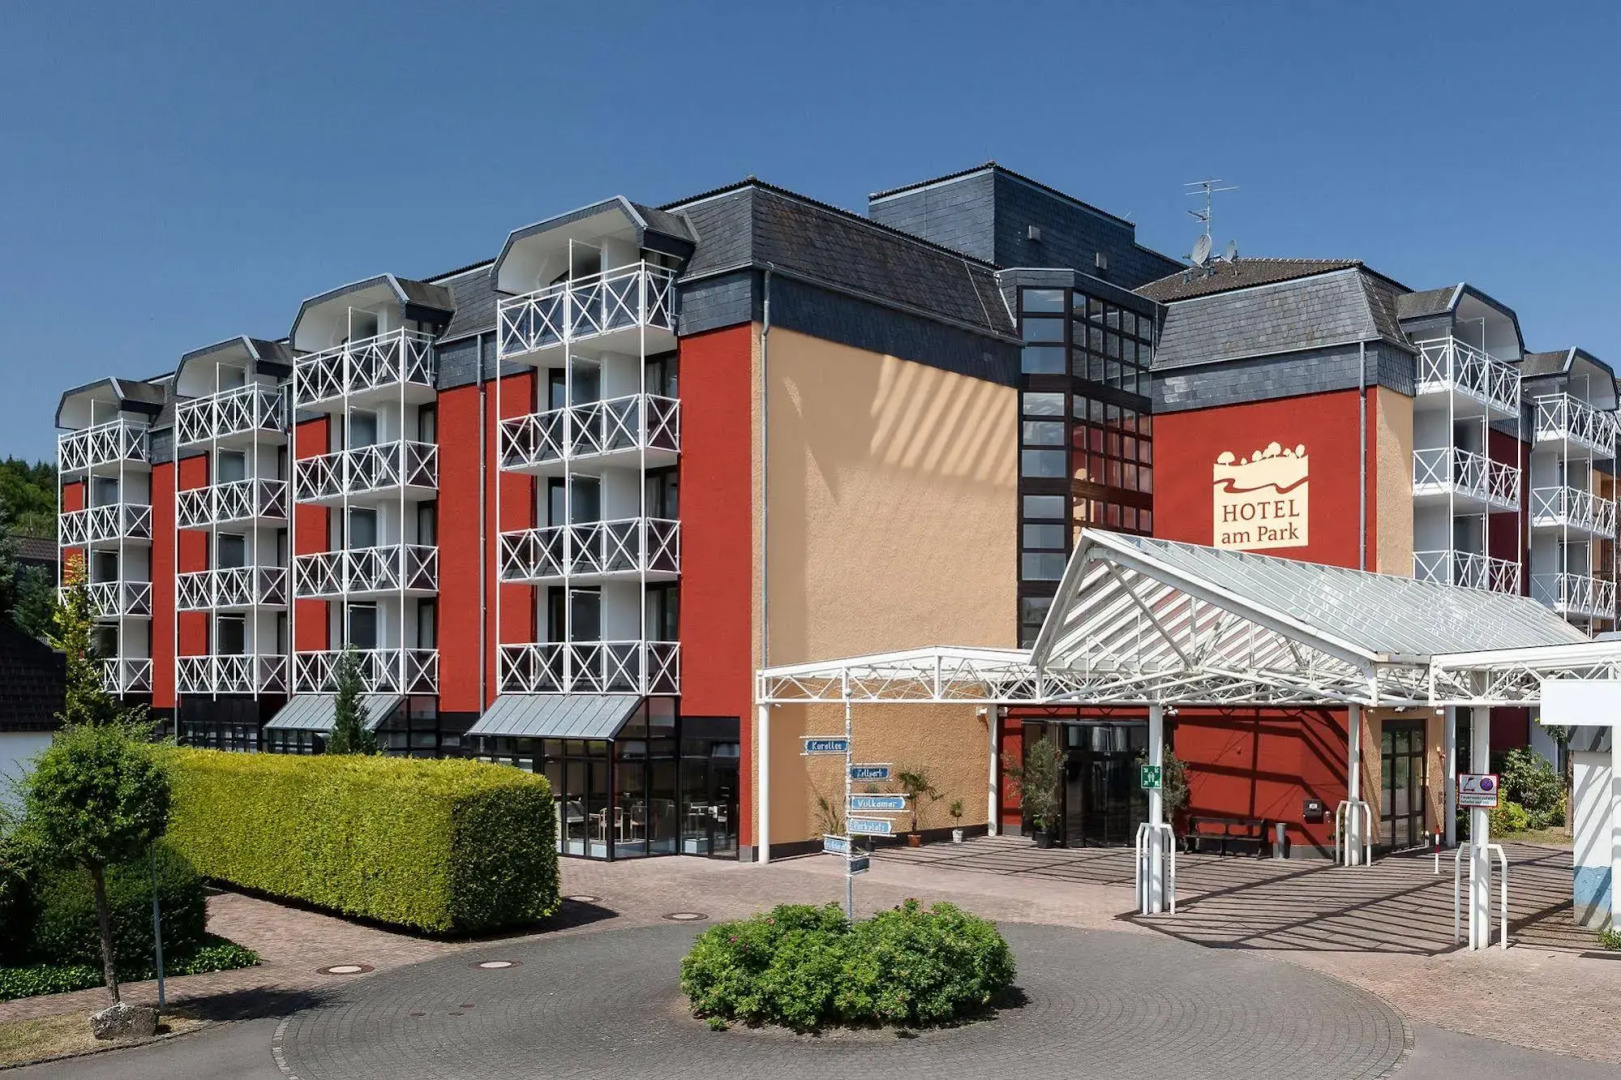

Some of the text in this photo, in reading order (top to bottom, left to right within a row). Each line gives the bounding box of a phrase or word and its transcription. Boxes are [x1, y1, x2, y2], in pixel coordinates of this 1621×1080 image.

[1222, 499, 1300, 523] HOTEL
[1222, 522, 1299, 544] am Park
